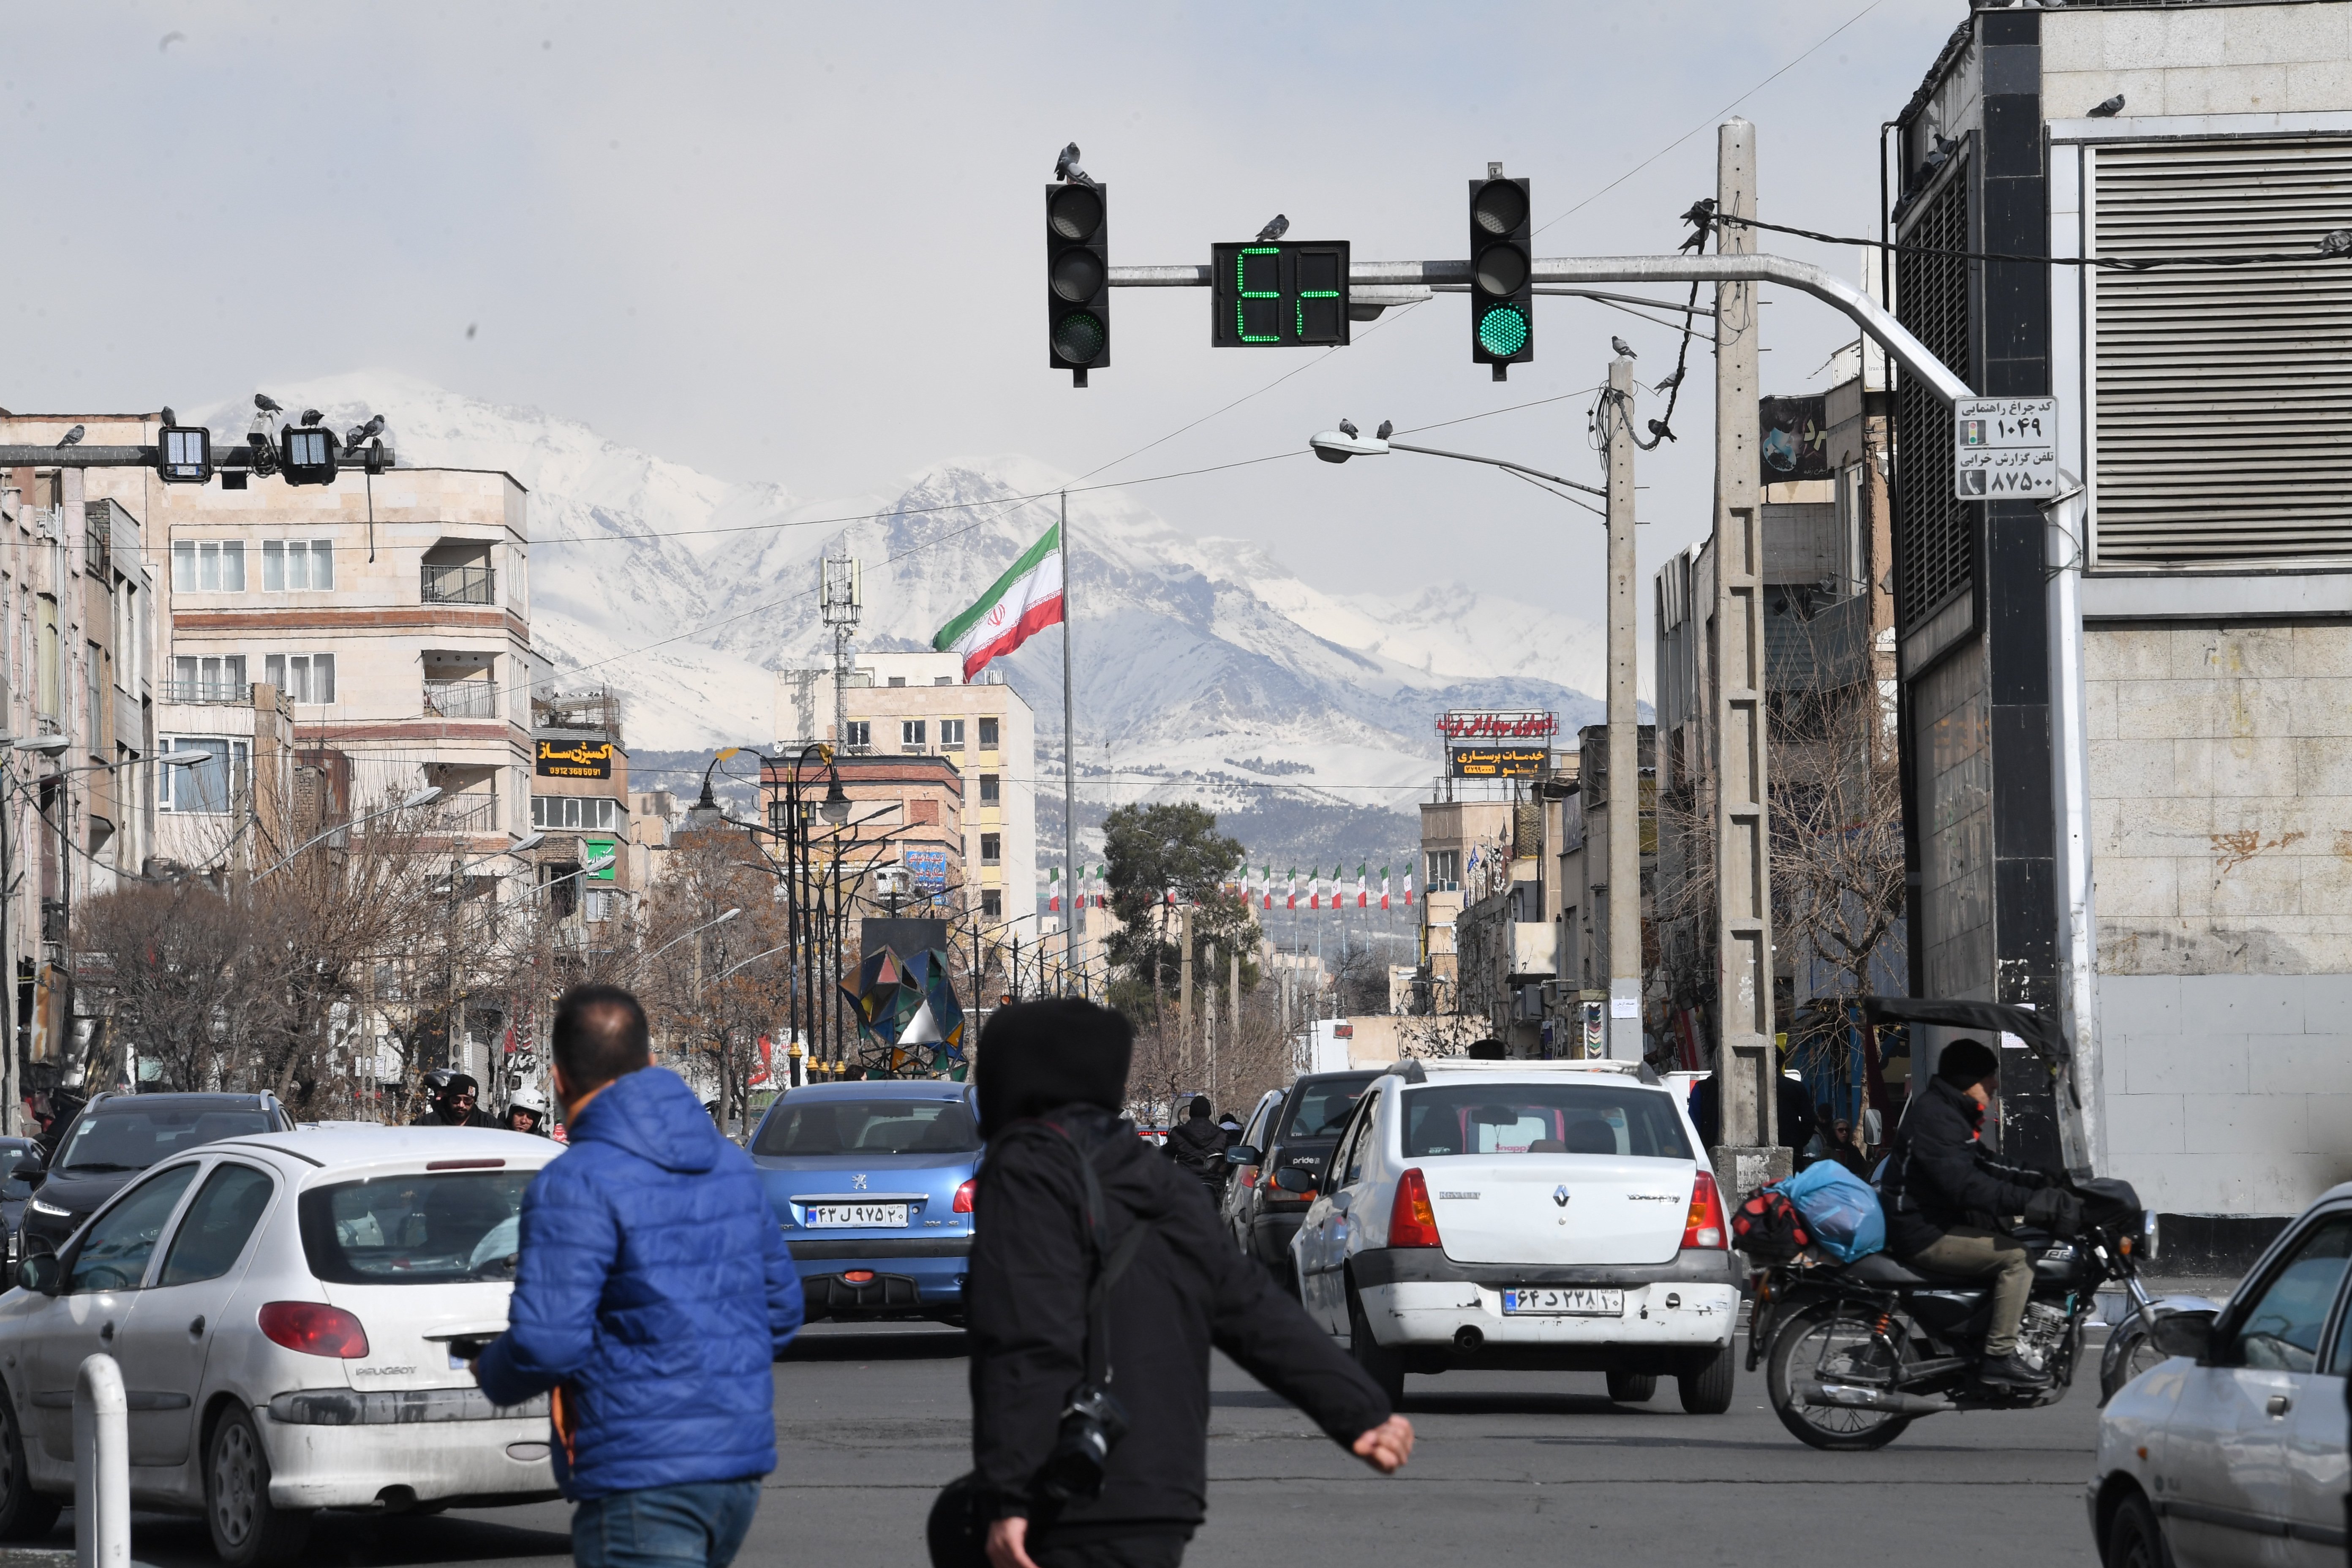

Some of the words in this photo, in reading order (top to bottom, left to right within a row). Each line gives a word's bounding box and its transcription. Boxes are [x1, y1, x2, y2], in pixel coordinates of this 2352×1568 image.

[1962, 402, 2006, 416] راهنمایی
[2009, 401, 2035, 415] چراغ
[2039, 401, 2052, 411] کد
[1998, 418, 2042, 438] ۱۰۴۹
[1960, 453, 1992, 467] خرابی
[1995, 452, 2030, 466] گزارش
[2033, 451, 2054, 465] تلفن
[1991, 471, 2053, 491] ۸۷۵۰۰
[1465, 713, 1512, 736] سونوگرافی
[1513, 713, 1557, 736] رادیولوژی
[539, 741, 571, 759] ساز
[571, 741, 613, 765] اکسیژن
[1457, 750, 1501, 764] پرستاری
[1502, 750, 1544, 761] خدمات
[1293, 1157, 1314, 1165] pride
[356, 1366, 417, 1376] PEUGEOT
